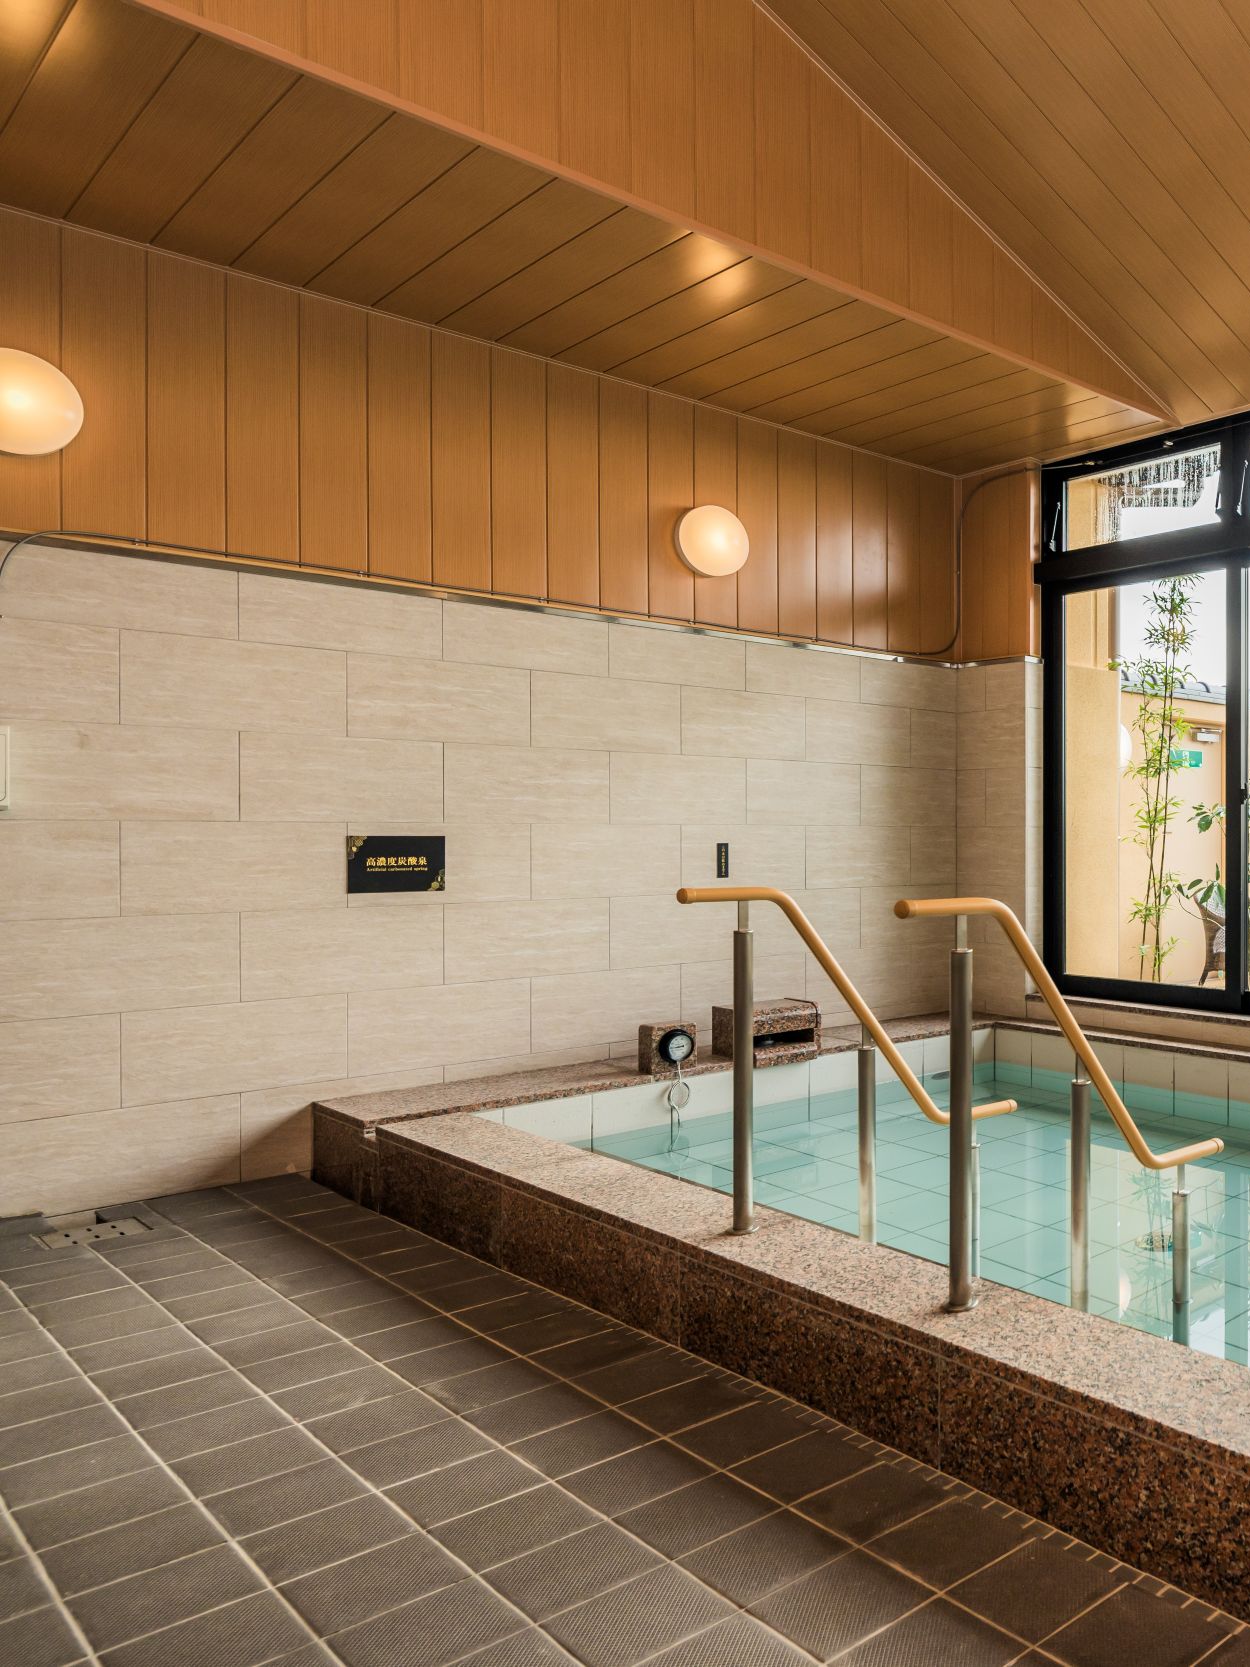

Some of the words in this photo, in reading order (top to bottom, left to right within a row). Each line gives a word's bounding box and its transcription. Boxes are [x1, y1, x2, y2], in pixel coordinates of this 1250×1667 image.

[366, 856, 427, 866] 高濃度炭酸泉
